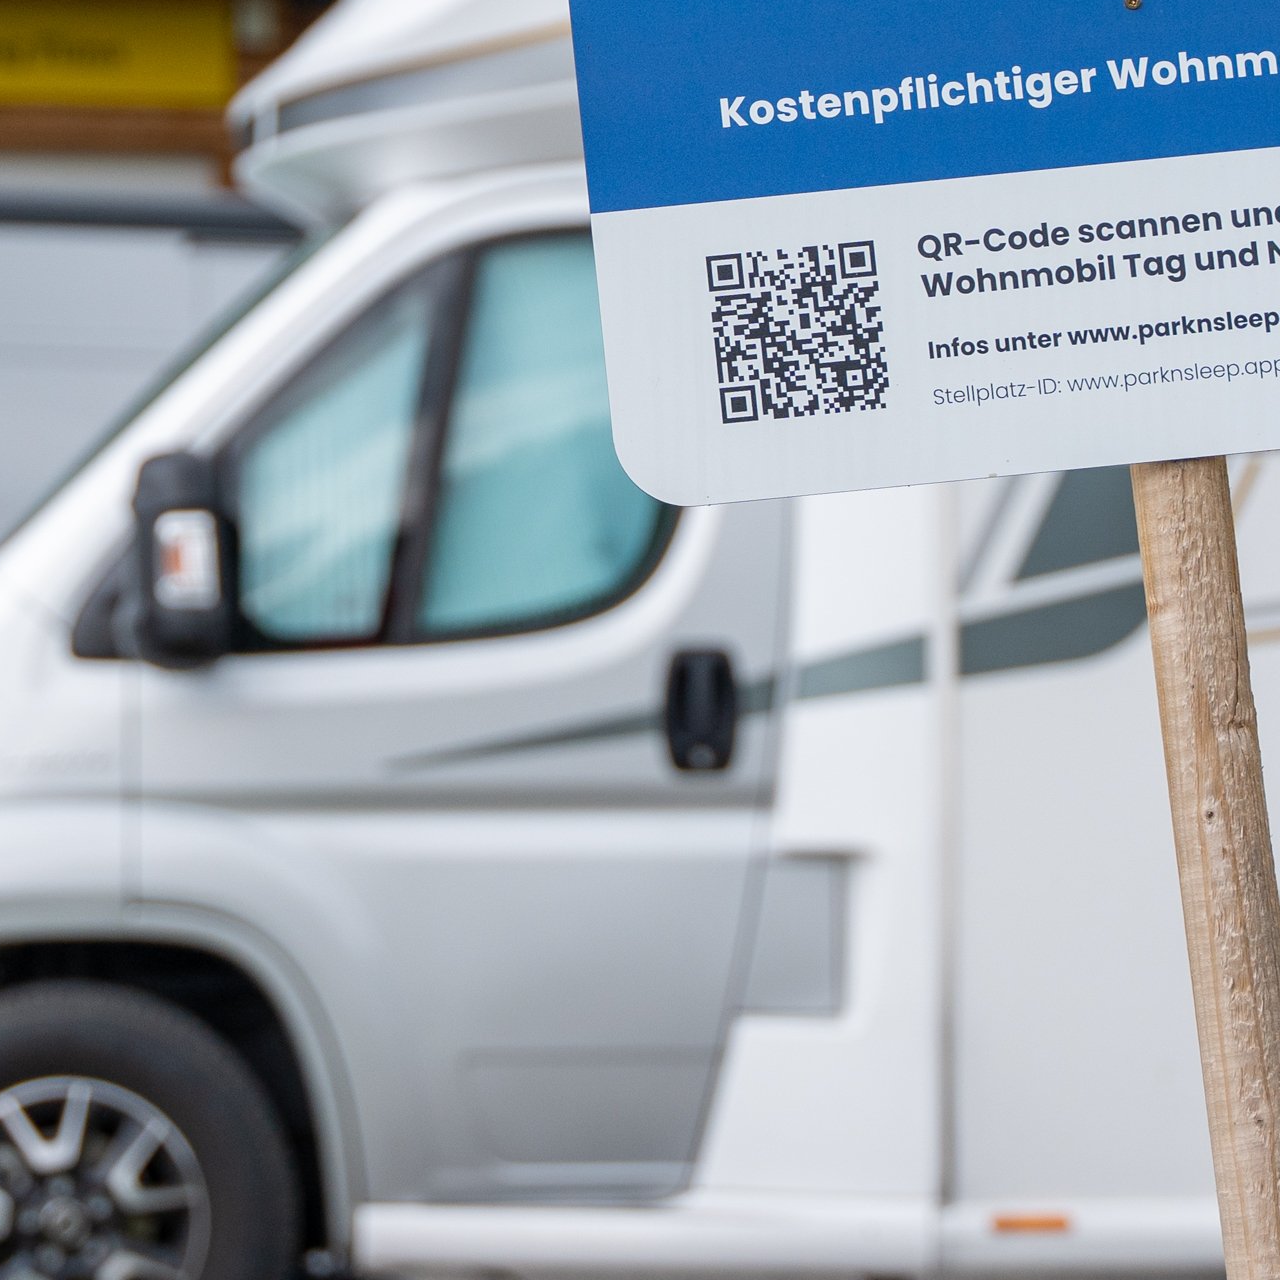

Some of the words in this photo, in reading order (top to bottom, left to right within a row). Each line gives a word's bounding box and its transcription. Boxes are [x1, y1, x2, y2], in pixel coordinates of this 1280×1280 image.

[720, 66, 1096, 128] Kostenpflichtiger
[918, 223, 1069, 261] QR-Code
[1079, 212, 1222, 243] scannen
[921, 254, 1115, 297] Wohnmobil
[1123, 254, 1186, 282] Tag
[1195, 241, 1259, 271] und
[929, 337, 988, 359] Infos
[996, 332, 1062, 352] unter
[934, 378, 1061, 406] Stellplatz-ID:
